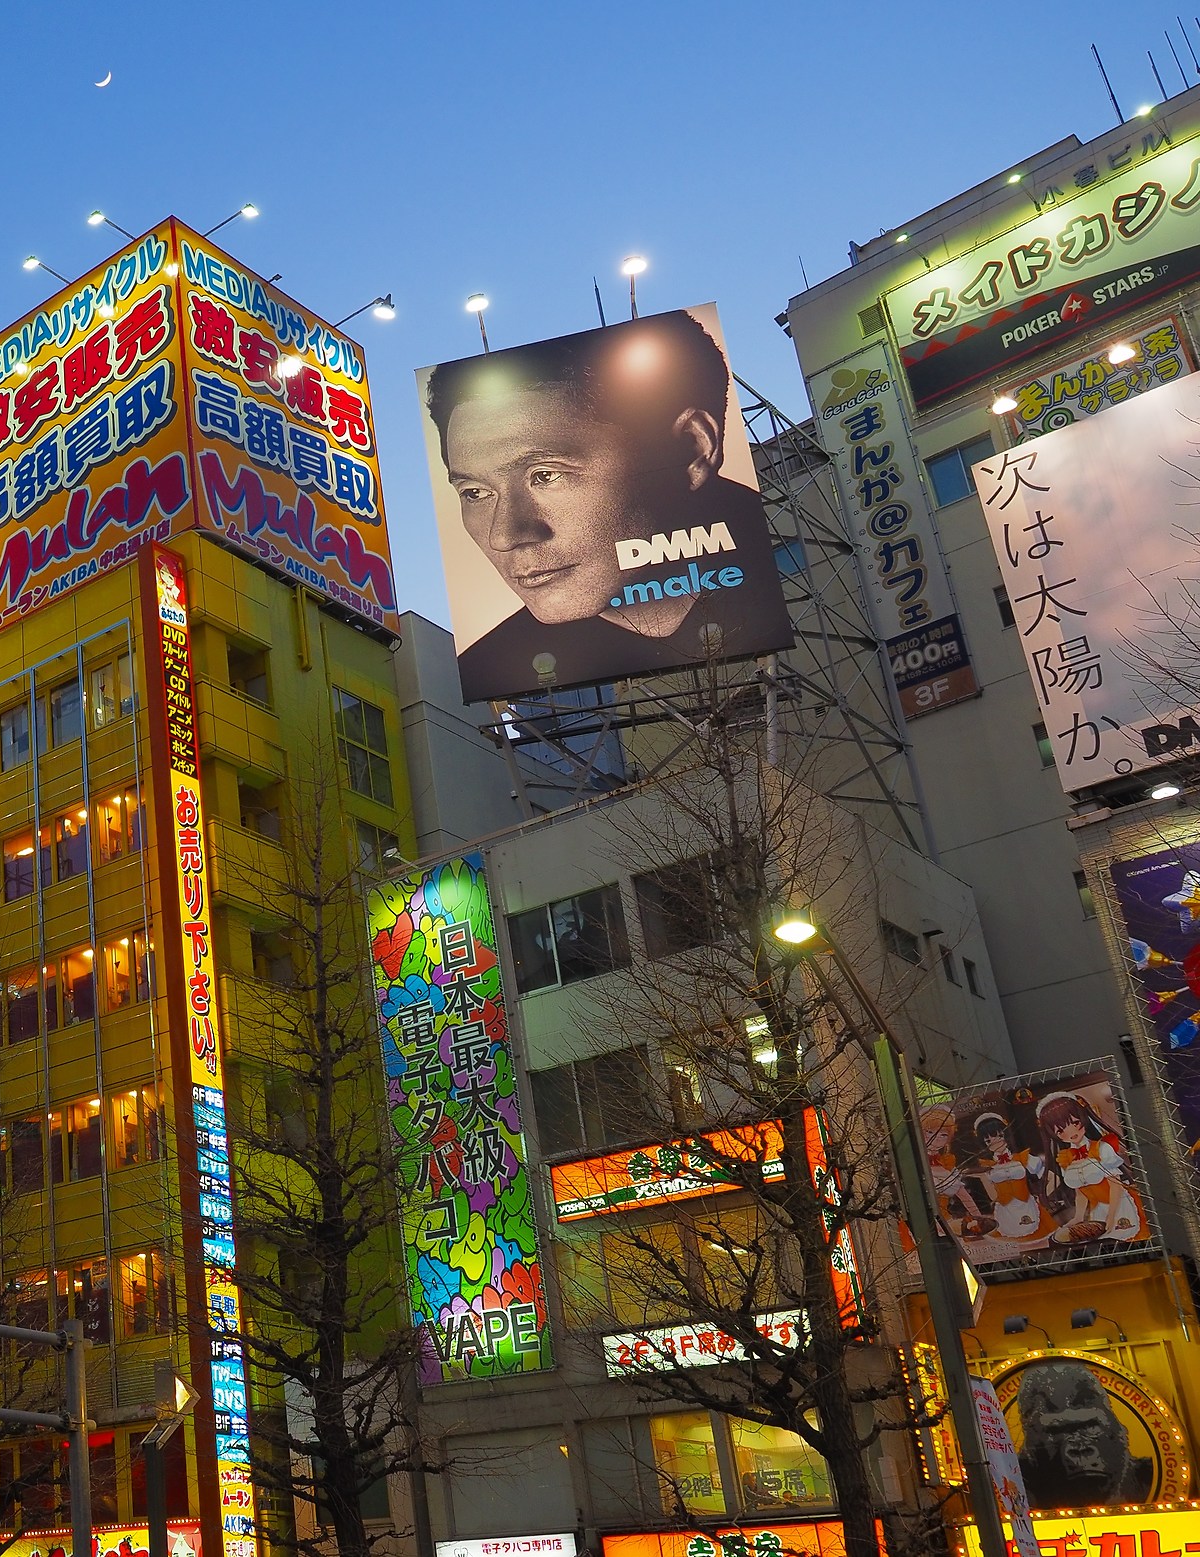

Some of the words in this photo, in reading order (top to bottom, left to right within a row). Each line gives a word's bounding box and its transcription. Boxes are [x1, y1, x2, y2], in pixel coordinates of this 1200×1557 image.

[181, 240, 364, 383] MEDIAリサイクル
[1001, 310, 1062, 349] POKER
[188, 290, 371, 450] 激安販売
[823, 380, 891, 420] GeraGera
[191, 368, 381, 520] 高額買取
[842, 403, 931, 628] まんが@カフェ
[197, 448, 398, 612] Mulan
[614, 521, 737, 571] DMM
[160, 605, 185, 624] あなたの
[980, 451, 1134, 775] 次は太陽か。
[163, 624, 186, 647] DVD
[162, 640, 188, 663] ブルーレイ
[892, 641, 960, 675] 400円
[164, 656, 190, 679] ゲーム
[169, 673, 186, 692] CD
[914, 678, 950, 706] 3F
[166, 688, 192, 710] アイドル
[167, 705, 193, 726] アニメ
[169, 723, 193, 742] コミック
[171, 739, 194, 758] ホビー
[171, 755, 196, 776] フィギュア
[437, 919, 510, 1185] 日本最大級
[193, 1086, 206, 1101] 6F
[397, 999, 460, 1241] 電子タバコ
[196, 1130, 209, 1144] 5F
[200, 1156, 227, 1175] DVD
[203, 1200, 230, 1221] DVD
[425, 1302, 542, 1364] VAPE
[214, 1388, 244, 1410] DVD
[222, 1489, 250, 1507] ムーラン
[482, 1537, 564, 1555] 電子タバコ専門店
